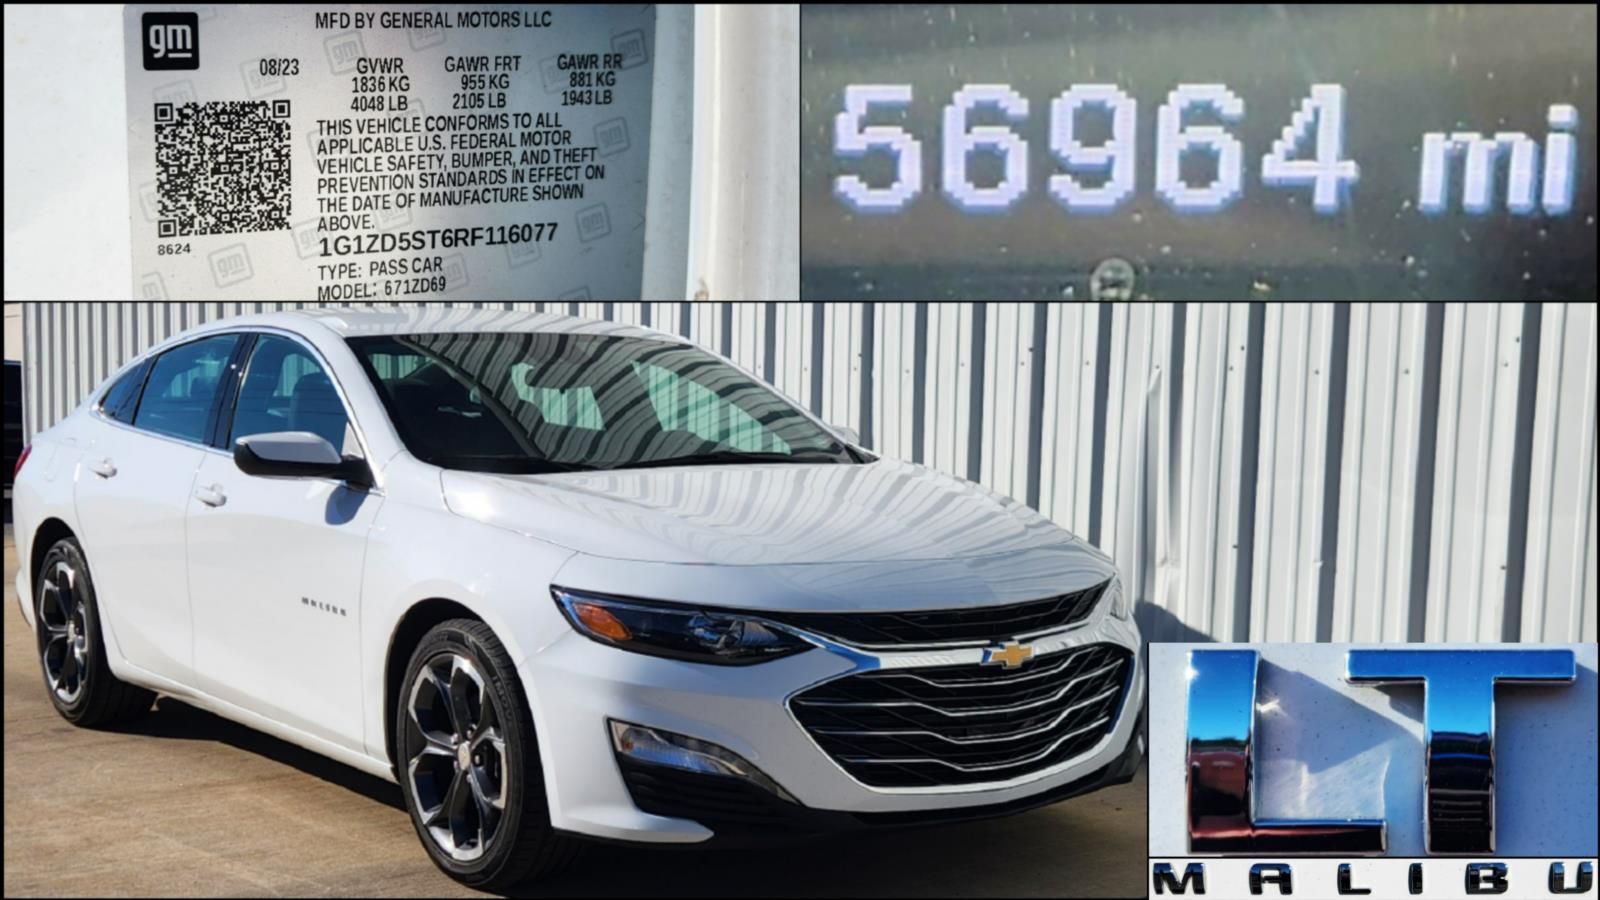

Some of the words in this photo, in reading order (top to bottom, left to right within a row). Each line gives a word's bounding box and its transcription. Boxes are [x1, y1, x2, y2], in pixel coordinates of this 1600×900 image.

[315, 12, 351, 28] MFD
[355, 12, 375, 28] BY
[380, 11, 453, 28] GENERAL
[457, 11, 521, 28] MOTORS
[524, 11, 552, 27] LLC
[150, 24, 193, 59] gm
[260, 58, 299, 76] 08/23
[357, 57, 404, 74] GVWR
[445, 56, 489, 72] GAWR
[495, 55, 522, 71] FRT
[557, 54, 598, 70] GAWR
[603, 53, 623, 69] RR
[352, 76, 385, 93] 1836
[389, 75, 410, 92] KG
[461, 74, 485, 90] 955
[489, 73, 510, 89] KG
[570, 72, 592, 87] 881
[596, 71, 616, 87] KG
[350, 95, 384, 112] 4048
[389, 95, 408, 111] LB
[453, 93, 485, 109] 2105
[488, 92, 506, 109] LB
[561, 90, 592, 106] 1943
[595, 89, 612, 105] LB
[316, 119, 352, 136] THIS
[356, 117, 421, 134] VEHICLE
[425, 113, 509, 132] CONFORMS
[513, 112, 532, 129] TO
[535, 112, 562, 128] ALL
[317, 136, 414, 155] APPLICABLE
[418, 134, 446, 151] U.S.
[451, 132, 516, 150] FEDERAL
[520, 130, 571, 147] MOTOR
[832, 82, 1361, 215] 56964
[1419, 104, 1579, 215] mi
[317, 156, 383, 174] VEHICLE
[387, 153, 447, 172] SAFETY,
[452, 151, 516, 169] BUMPER,
[520, 149, 551, 166] AND
[554, 147, 598, 164] THEFT
[317, 174, 414, 194] PREVENTION
[419, 169, 507, 189] STANDARDS
[512, 168, 525, 184] IN
[529, 166, 581, 183] EFFECT
[585, 165, 605, 180] ON
[317, 196, 348, 213] THE
[352, 194, 391, 211] DATE
[396, 193, 416, 209] OF
[420, 187, 529, 207] MANUFACTURE
[532, 184, 584, 201] SHOWN
[317, 214, 375, 232] ABOVE.
[319, 222, 559, 257] 1G1ZD5ST6RF116077
[157, 243, 191, 256] 8624
[317, 263, 362, 280] TYPE:
[369, 258, 408, 276] PASS
[412, 256, 443, 274] CAR
[317, 282, 377, 301] MODEL:
[384, 276, 446, 296] 671ZD69
[1185, 648, 1577, 857] LT
[1152, 862, 1594, 896] MALIBU
